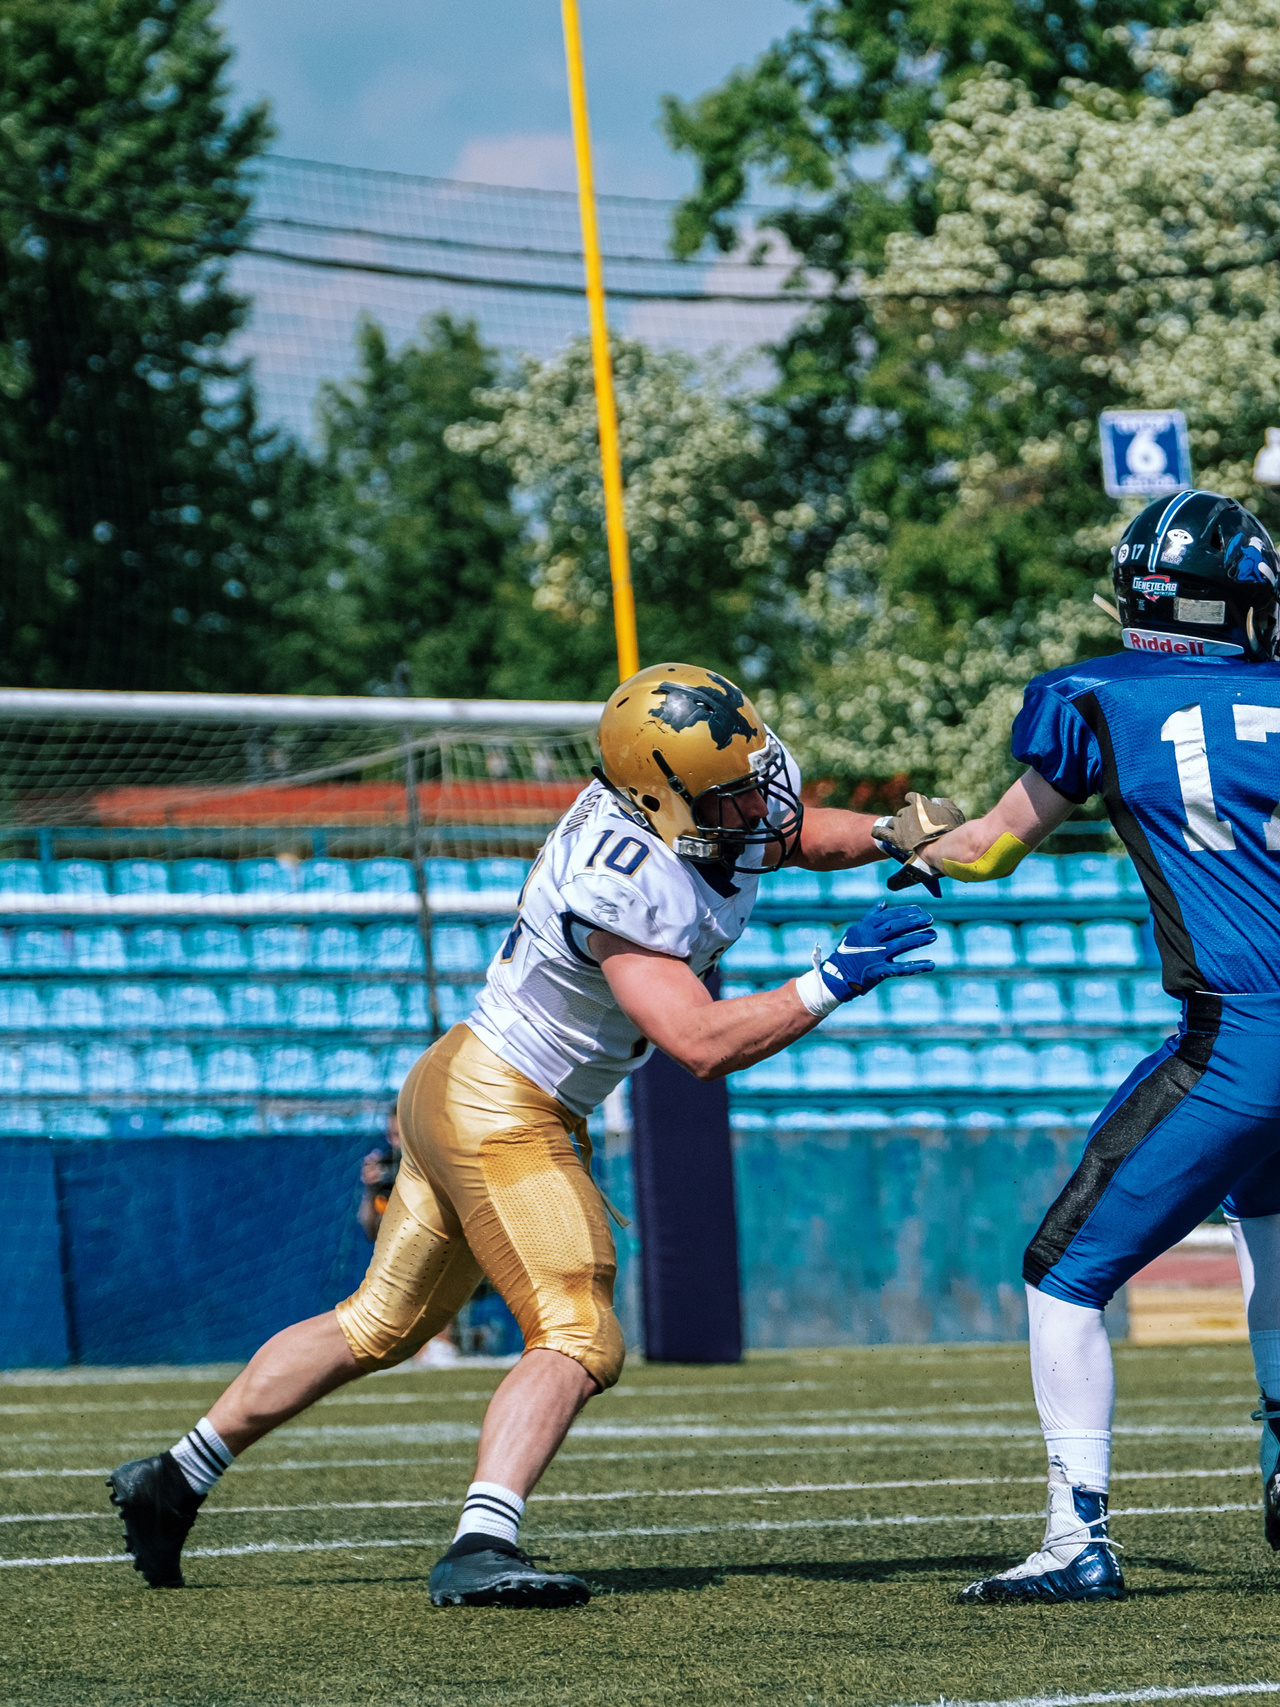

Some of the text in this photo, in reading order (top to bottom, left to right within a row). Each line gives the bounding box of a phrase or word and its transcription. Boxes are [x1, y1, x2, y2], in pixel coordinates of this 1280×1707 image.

[1126, 426, 1168, 476] 6
[1131, 544, 1146, 560] 17
[1129, 632, 1204, 656] Riddell
[584, 829, 652, 878] 10
